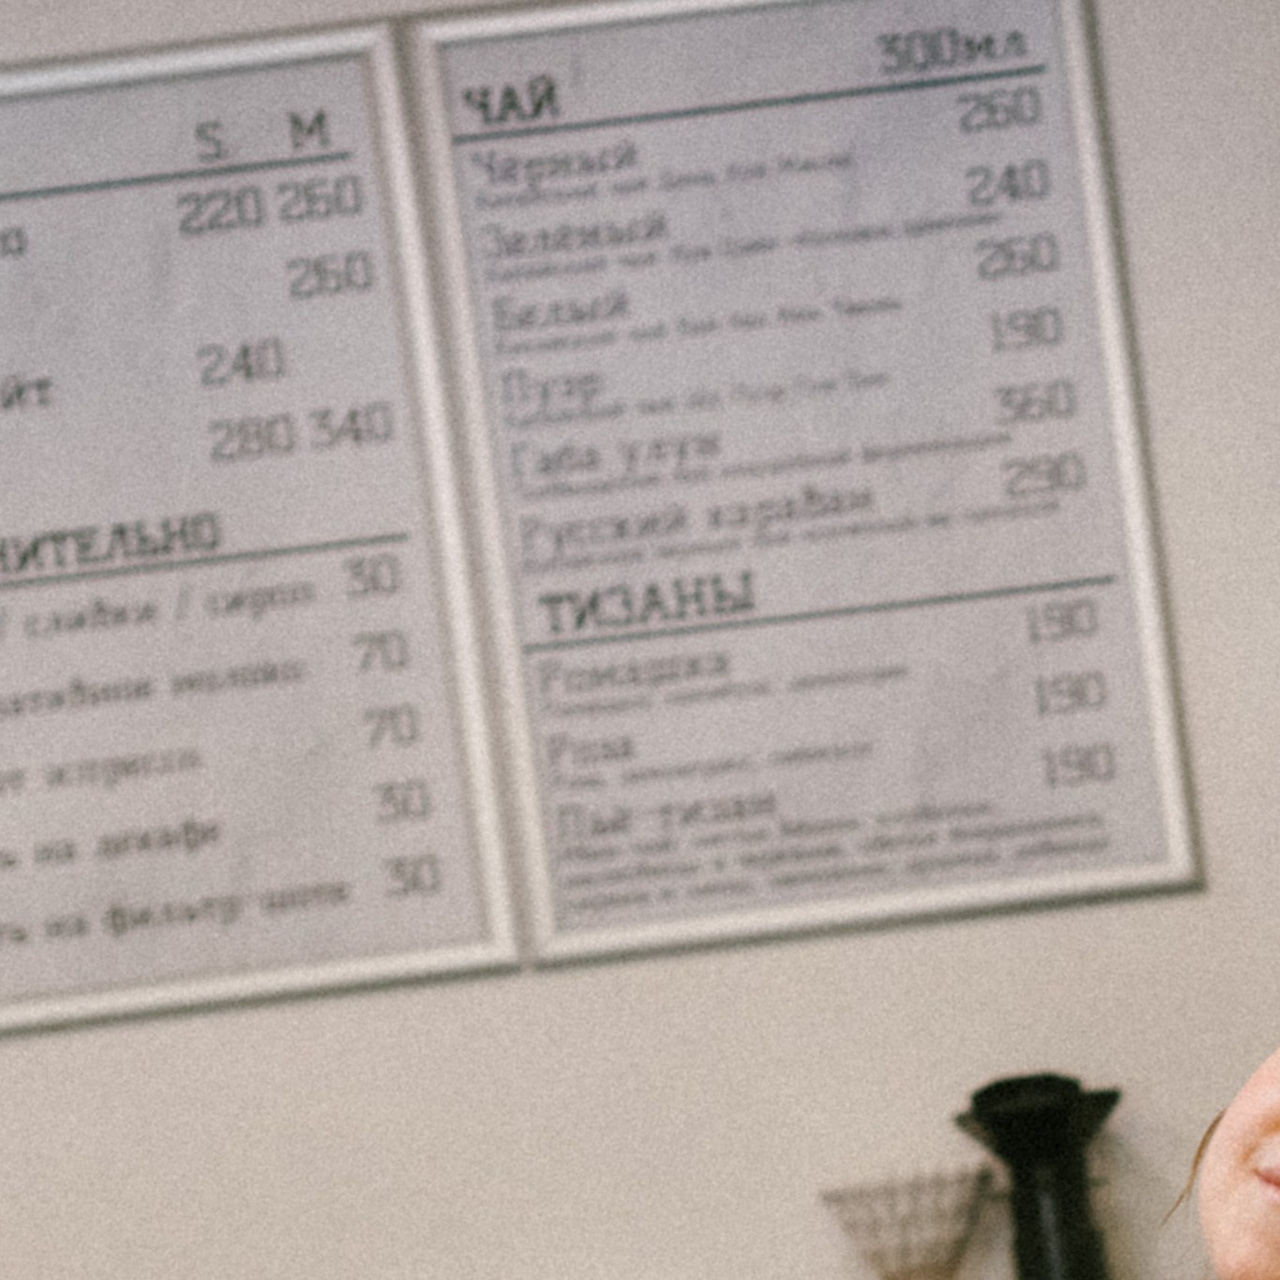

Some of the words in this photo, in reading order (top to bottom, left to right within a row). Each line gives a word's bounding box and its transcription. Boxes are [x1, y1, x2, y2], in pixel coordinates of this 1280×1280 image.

[463, 74, 560, 124] ЧАЙ
[195, 120, 228, 162] S
[288, 108, 331, 149] M
[965, 158, 1051, 207] 240
[178, 186, 267, 236] 220
[197, 337, 286, 387] 240
[308, 402, 395, 451] 340
[537, 568, 756, 634] ТИЗАНЫ
[353, 627, 413, 675] 70
[363, 702, 422, 752] 70
